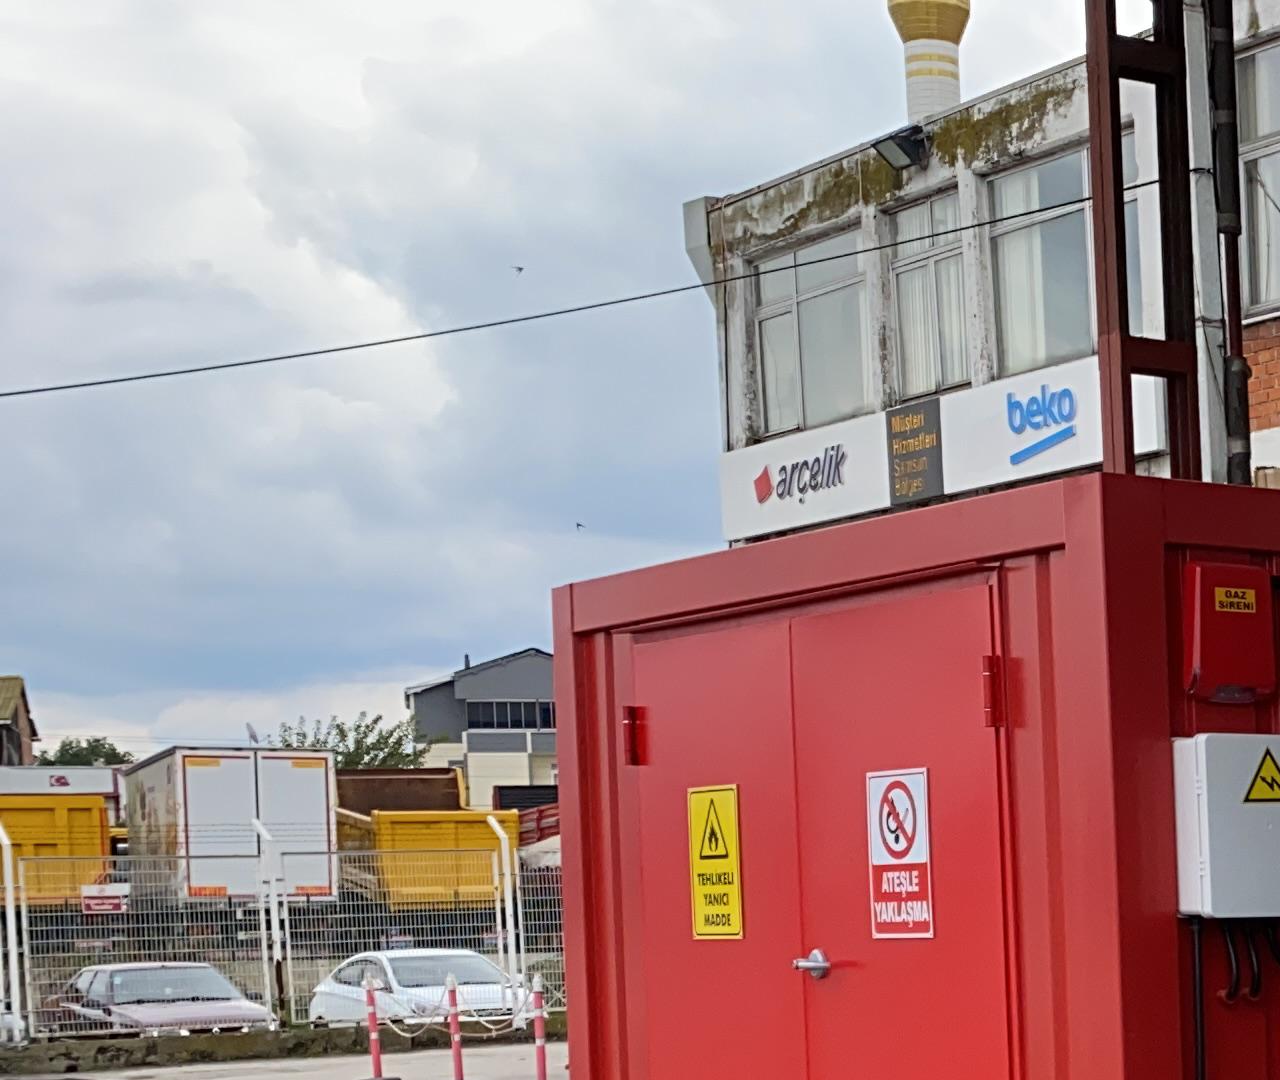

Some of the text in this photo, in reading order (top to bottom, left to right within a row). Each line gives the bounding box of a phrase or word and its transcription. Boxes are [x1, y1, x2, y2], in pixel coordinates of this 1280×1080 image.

[1007, 384, 1076, 435] beko
[891, 413, 924, 434] Müşteri
[893, 431, 936, 455] Hizmetleri
[776, 443, 847, 504] arçelik
[1225, 590, 1247, 600] GAZ
[882, 870, 920, 897] ATEŞLE
[703, 893, 730, 907] YANICI
[704, 914, 732, 926] MADDE
[874, 900, 930, 928] YAKLAŞMA
